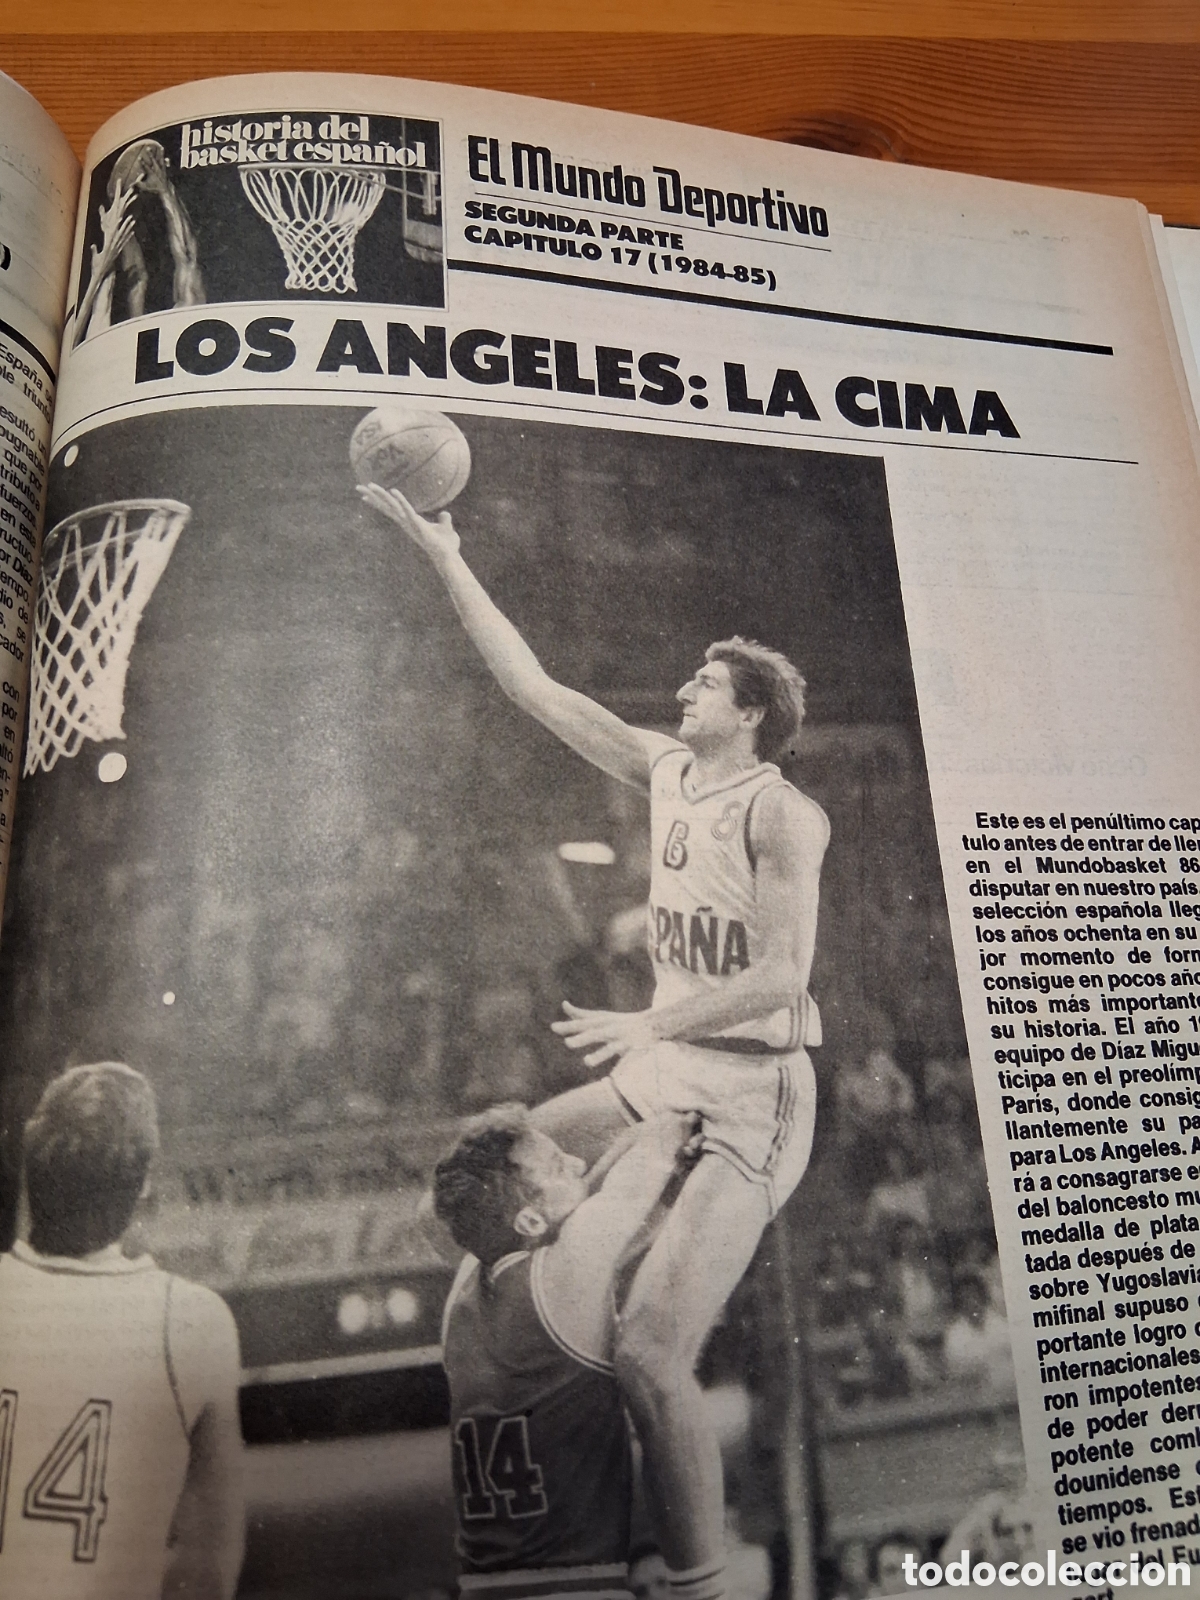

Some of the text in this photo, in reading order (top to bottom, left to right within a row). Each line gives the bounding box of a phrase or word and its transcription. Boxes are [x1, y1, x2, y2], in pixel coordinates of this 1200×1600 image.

[181, 114, 370, 148] historia del
[180, 138, 427, 170] basket español
[511, 141, 647, 208] Mundo
[652, 166, 830, 238] Deportivo
[464, 201, 684, 251] SEGUNDA PARTE
[464, 225, 778, 292] CAPITULO 17 (1984-85)
[134, 316, 1022, 439] LOS ANGELES: LA CIMA
[3, 448, 43, 493] que por
[0, 507, 16, 528] en
[12, 556, 33, 587] Díaz
[18, 606, 29, 625] de
[2, 680, 20, 701] con
[1, 701, 18, 722] por
[3, 724, 16, 743] en
[975, 811, 1200, 835] Este es el penúltimo cap
[662, 819, 690, 872] 6
[961, 833, 1001, 851] tulo
[1003, 834, 1058, 852] antes
[1059, 834, 1085, 852] de
[1087, 835, 1145, 852] entrar
[1147, 834, 1172, 852] de
[965, 860, 991, 874] en
[1004, 856, 1023, 874] el
[1035, 856, 1168, 874] Mundobasket
[968, 878, 1051, 901] disputar
[1054, 882, 1080, 897] en
[1083, 879, 1156, 896] nuestro
[972, 900, 1068, 920] selección
[1075, 900, 1163, 923] española
[975, 923, 1198, 943] los años ochenta en su
[979, 948, 1007, 972] jor
[1019, 947, 1115, 967] momento
[1127, 946, 1152, 965] de
[983, 971, 1075, 994] consigue
[1078, 974, 1104, 989] en
[1107, 972, 1167, 992] pocos
[986, 995, 1038, 1015] hitos
[1047, 993, 1091, 1014] más
[990, 1015, 1200, 1040] su historia. El año 1
[994, 1043, 1065, 1068] equipo
[1070, 1042, 1097, 1062] de
[1101, 1039, 1147, 1061] Díaz
[997, 1068, 1057, 1093] ticipa
[1061, 1071, 1088, 1087] en
[1093, 1065, 1113, 1086] el
[1001, 1092, 1060, 1116] París,
[1067, 1090, 1132, 1112] donde
[1005, 1116, 1129, 1141] llantemente
[1141, 1116, 1166, 1133] su
[1009, 1149, 1057, 1172] para
[1058, 1143, 1097, 1164] Los
[1100, 1138, 1188, 1164] Angeles.
[1013, 1170, 1036, 1193] rá
[1039, 1175, 1053, 1192] a
[1056, 1166, 1183, 1191] consagrarse
[1017, 1196, 1051, 1220] del
[1055, 1190, 1170, 1217] baloncesto
[1020, 1213, 1200, 1247] medalla de plata
[1024, 1238, 1196, 1274] tada después de
[1028, 1263, 1200, 1301] sobre Yugoslavi
[1032, 1296, 1189, 1329] mifinal supuso
[1036, 1327, 1127, 1362] portante
[1132, 1323, 1187, 1347] logro
[1043, 1391, 1080, 1412] ron
[1046, 1416, 1075, 1440] de
[1086, 1407, 1149, 1440] poder
[454, 1414, 549, 1521] 14
[1050, 1438, 1135, 1474] potente
[1053, 1462, 1181, 1498] dounidense
[1057, 1496, 1153, 1527] tiempos.
[1061, 1534, 1089, 1556] se
[1091, 1525, 1127, 1550] vio
